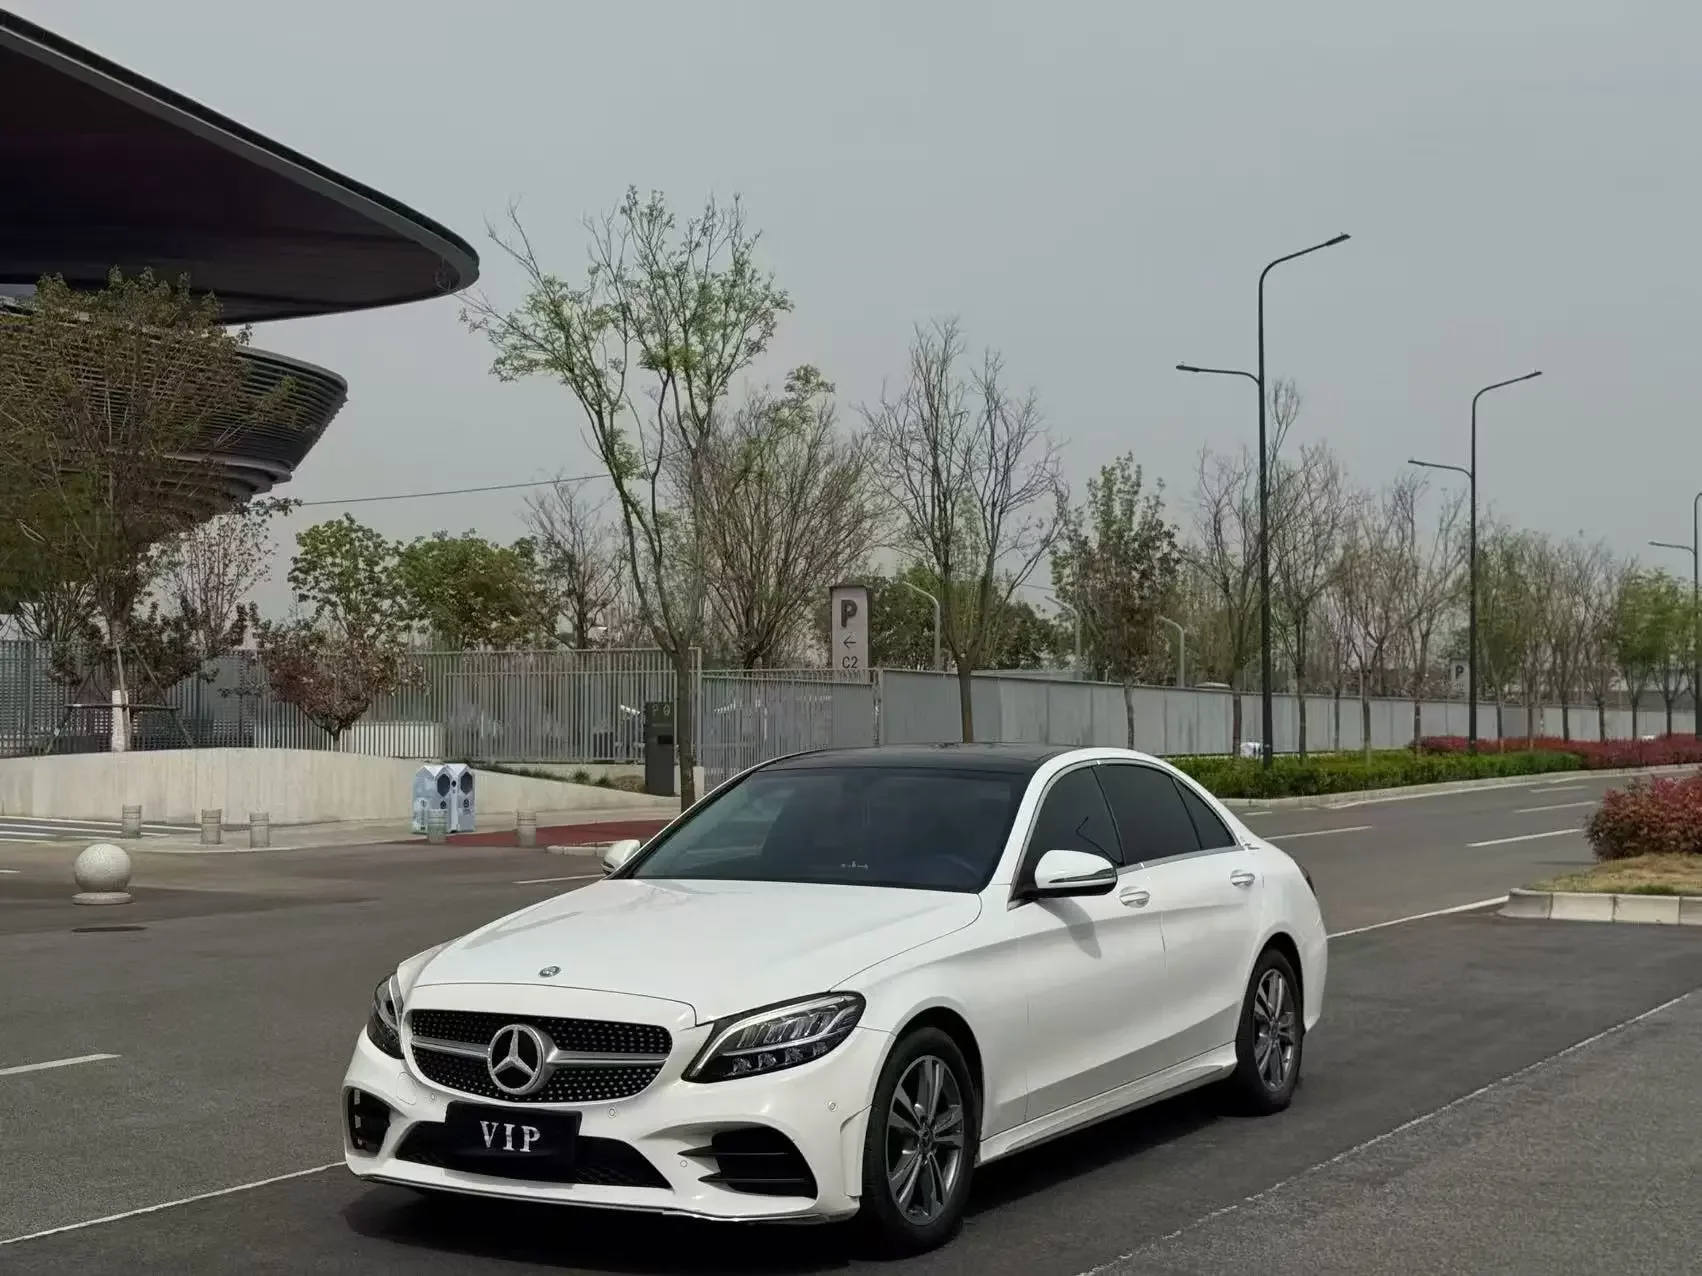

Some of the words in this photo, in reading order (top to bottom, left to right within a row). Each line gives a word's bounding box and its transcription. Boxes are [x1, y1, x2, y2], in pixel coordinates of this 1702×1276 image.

[841, 599, 858, 628] P
[842, 656, 858, 669] C2
[1455, 665, 1464, 680] P
[480, 1120, 541, 1153] VIP
